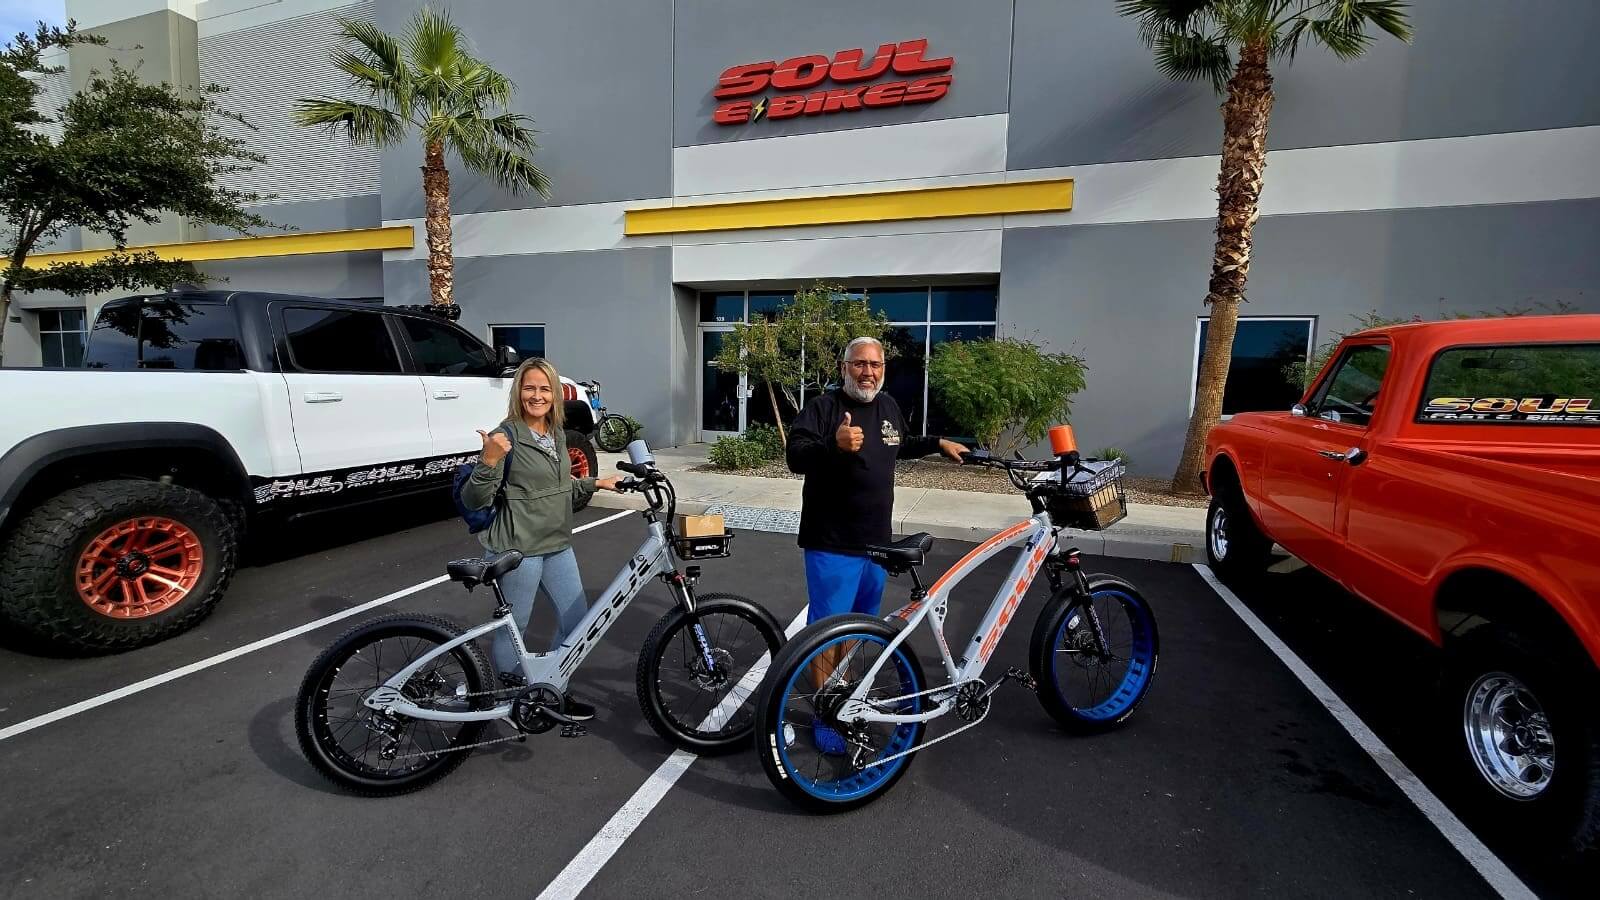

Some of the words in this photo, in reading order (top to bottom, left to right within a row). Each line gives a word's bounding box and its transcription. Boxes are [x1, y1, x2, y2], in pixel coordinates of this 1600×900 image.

[713, 38, 953, 100] SOUL
[1424, 397, 1600, 414] SOUL
[253, 476, 344, 499] SOUL
[559, 550, 662, 678] SOUL
